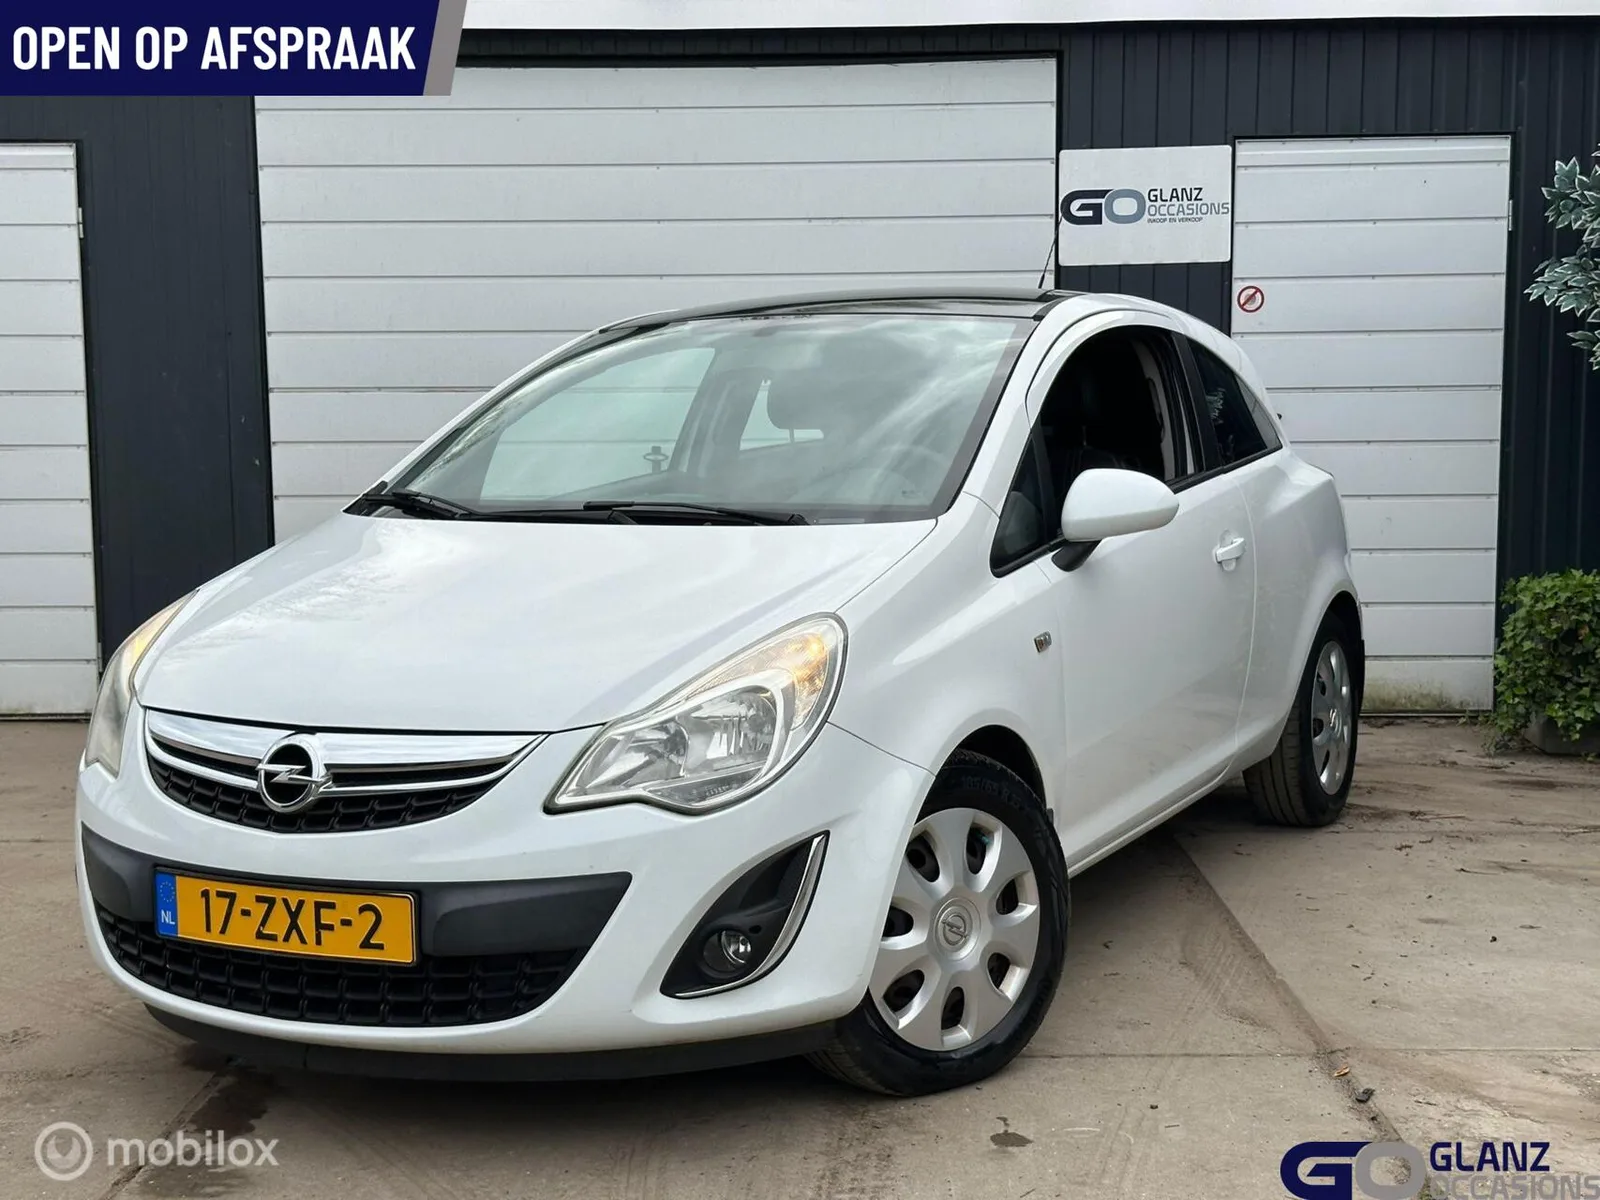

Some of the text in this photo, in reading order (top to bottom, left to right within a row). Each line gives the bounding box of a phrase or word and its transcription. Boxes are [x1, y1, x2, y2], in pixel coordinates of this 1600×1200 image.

[1147, 187, 1203, 202] GLANZ
[1060, 188, 1146, 225] GO
[1147, 202, 1230, 217] OCCASIONS
[161, 910, 175, 925] NL
[200, 888, 386, 951] 17-ZXF-2
